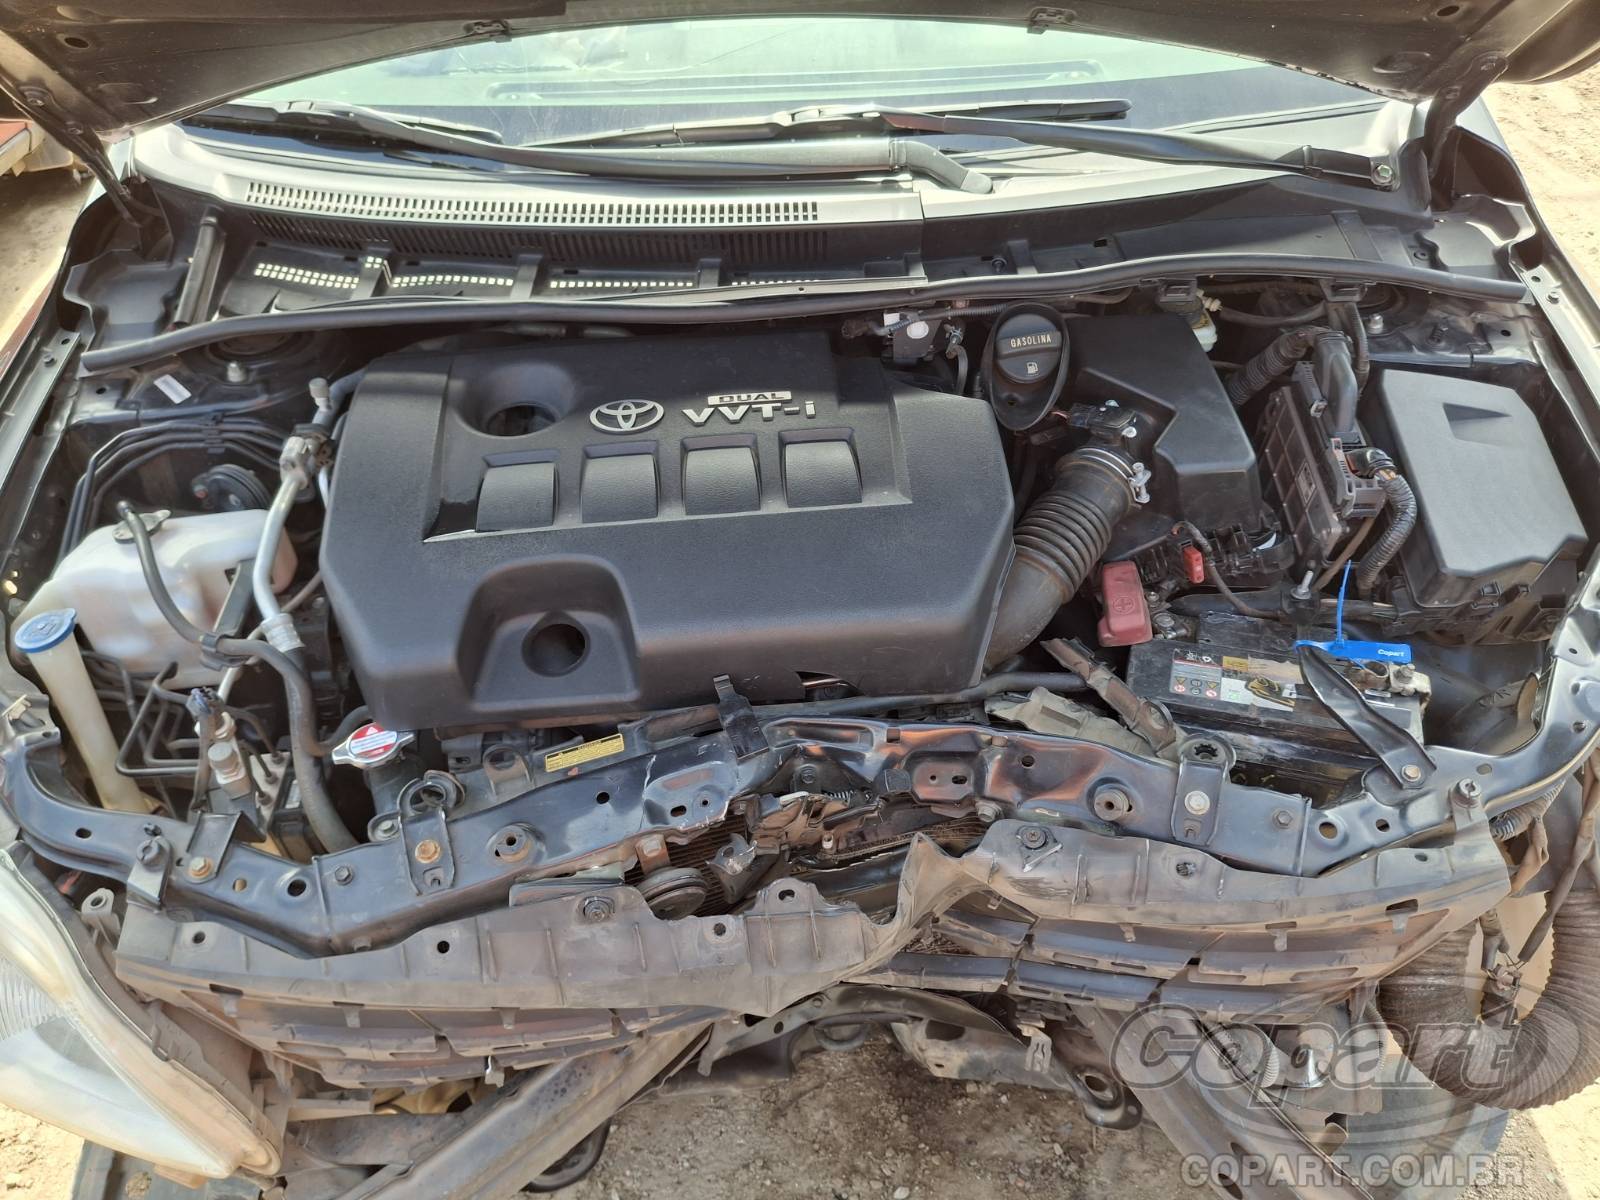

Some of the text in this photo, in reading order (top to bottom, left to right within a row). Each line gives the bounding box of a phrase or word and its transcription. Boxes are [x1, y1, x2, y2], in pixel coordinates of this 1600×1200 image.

[1010, 333, 1052, 348] GASOLINA
[718, 392, 786, 403] DUAL
[682, 400, 816, 426] VVT-i
[1377, 648, 1405, 657] Copart
